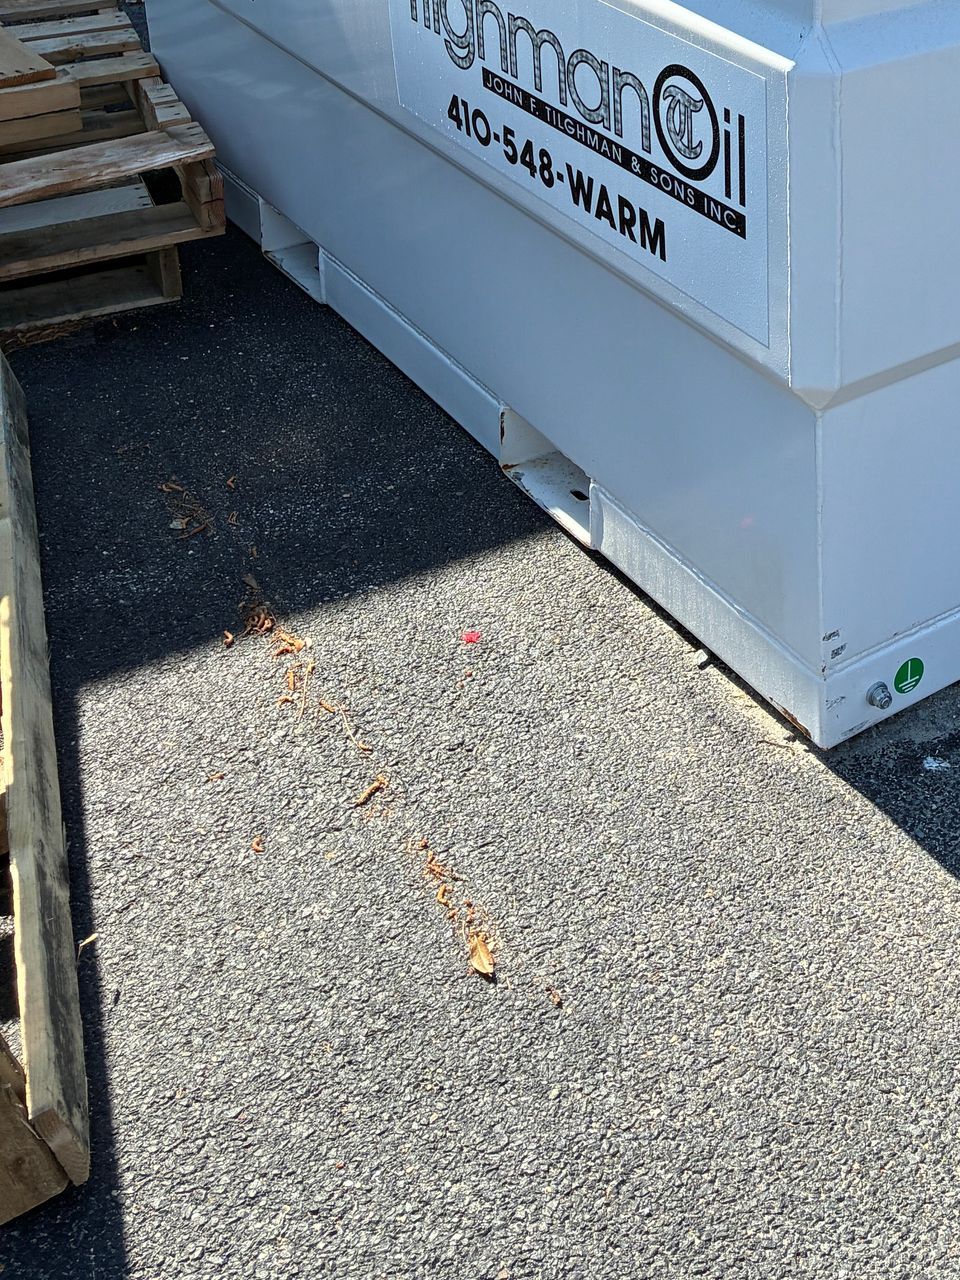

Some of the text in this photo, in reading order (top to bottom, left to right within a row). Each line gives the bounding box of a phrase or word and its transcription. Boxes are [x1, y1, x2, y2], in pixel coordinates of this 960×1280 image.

[447, 94, 667, 262] 410-548-WARM
[486, 73, 741, 233] JOHN F. TILGHMAN & SONS INC.
